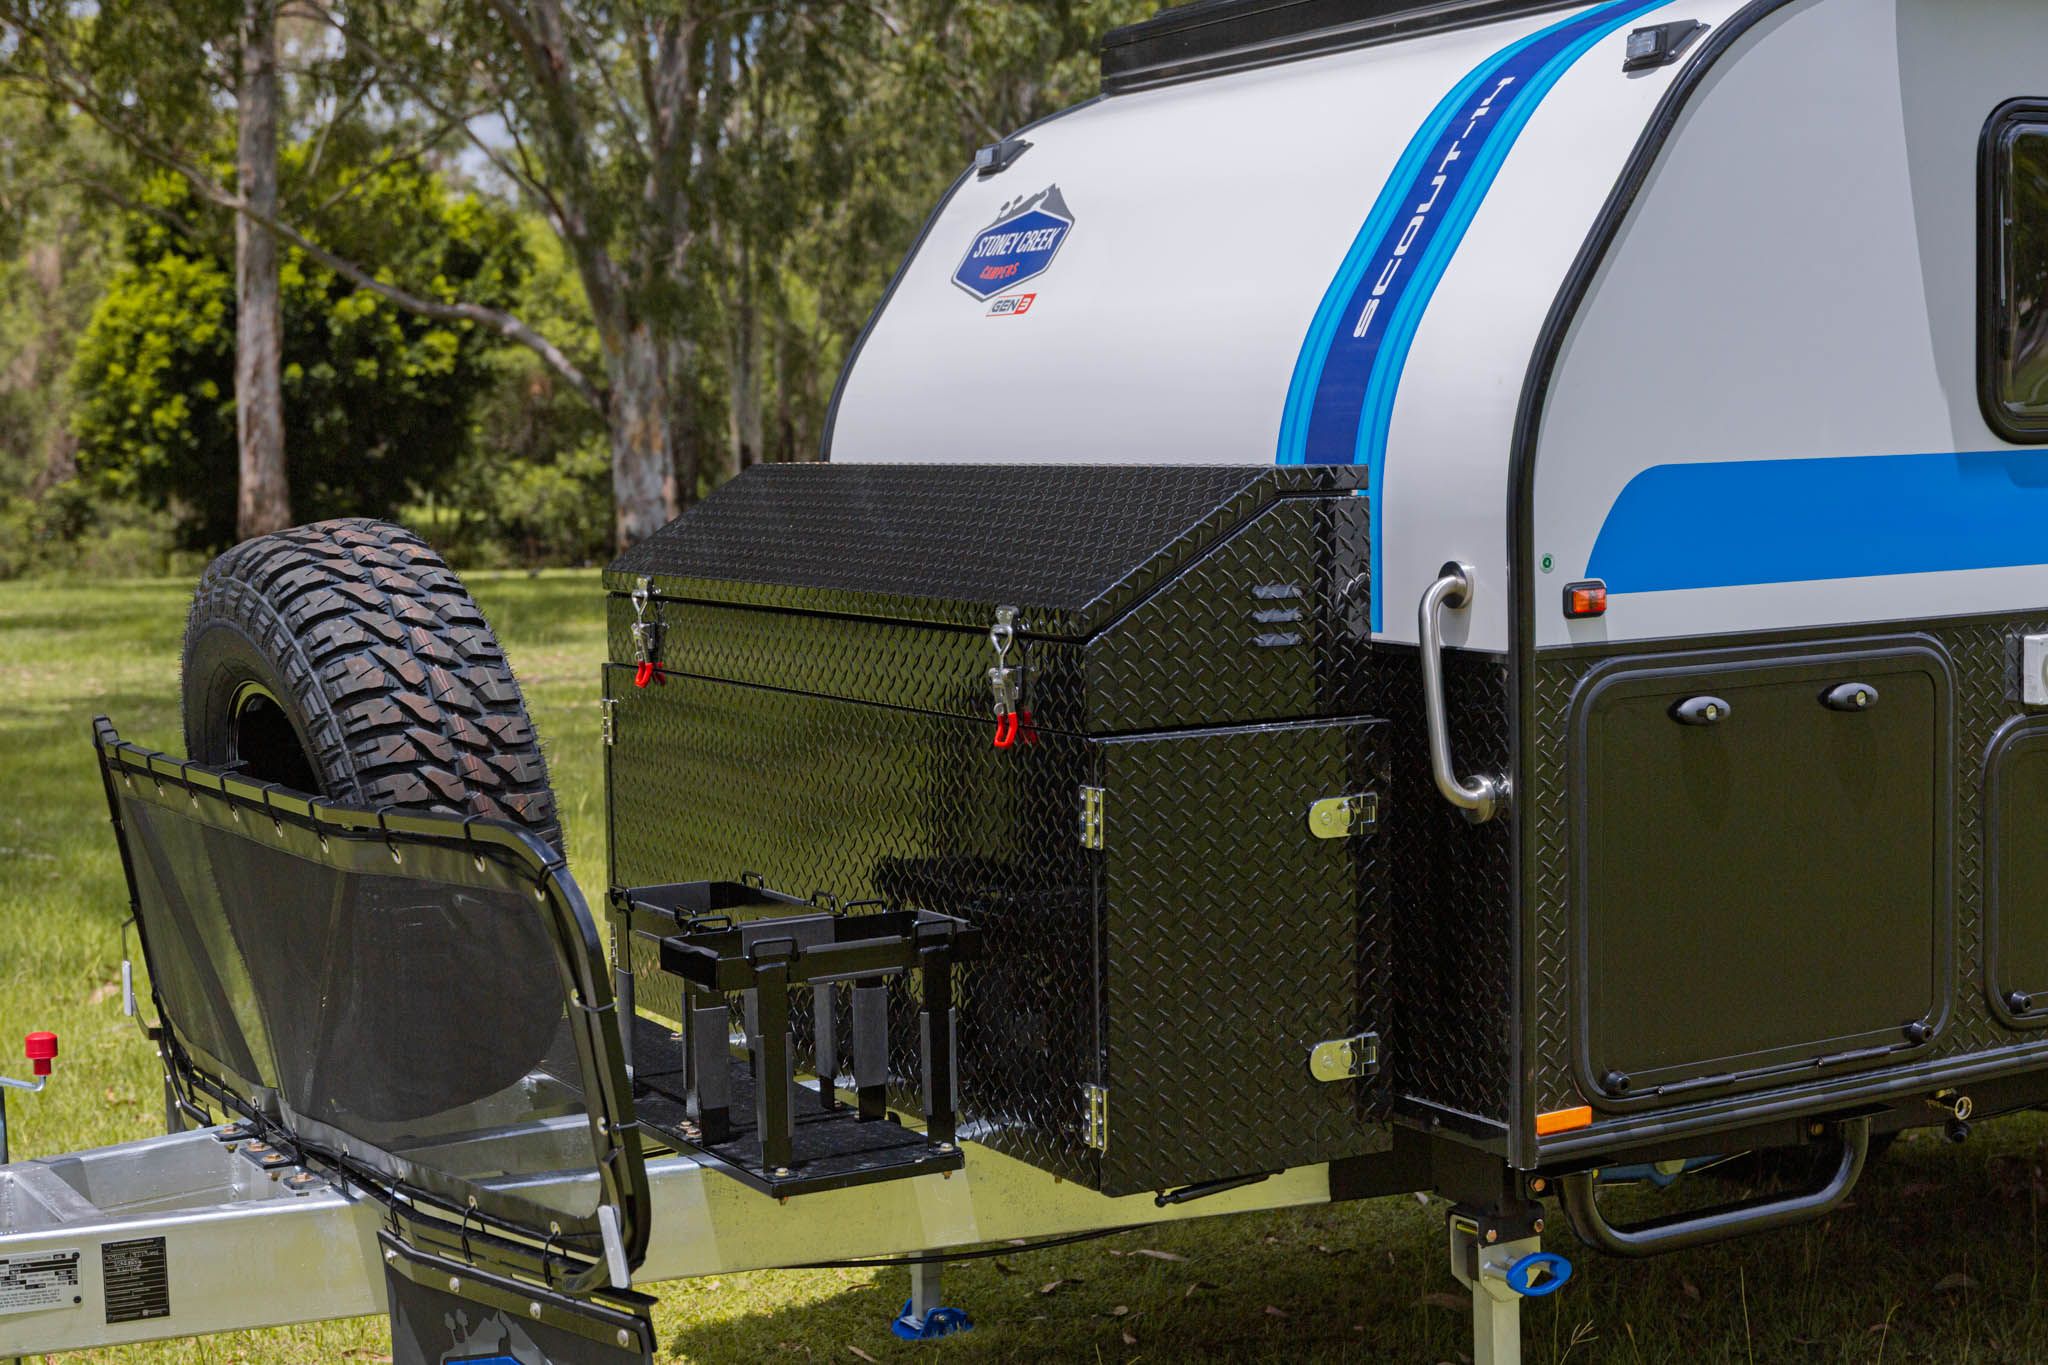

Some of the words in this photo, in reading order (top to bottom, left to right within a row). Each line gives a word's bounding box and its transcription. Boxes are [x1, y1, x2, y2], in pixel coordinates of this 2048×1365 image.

[1353, 76, 1516, 338] SCOUT-14
[973, 231, 1024, 258] STONEY
[1015, 226, 1063, 254] CREEK
[979, 262, 1020, 279] CAMPERS
